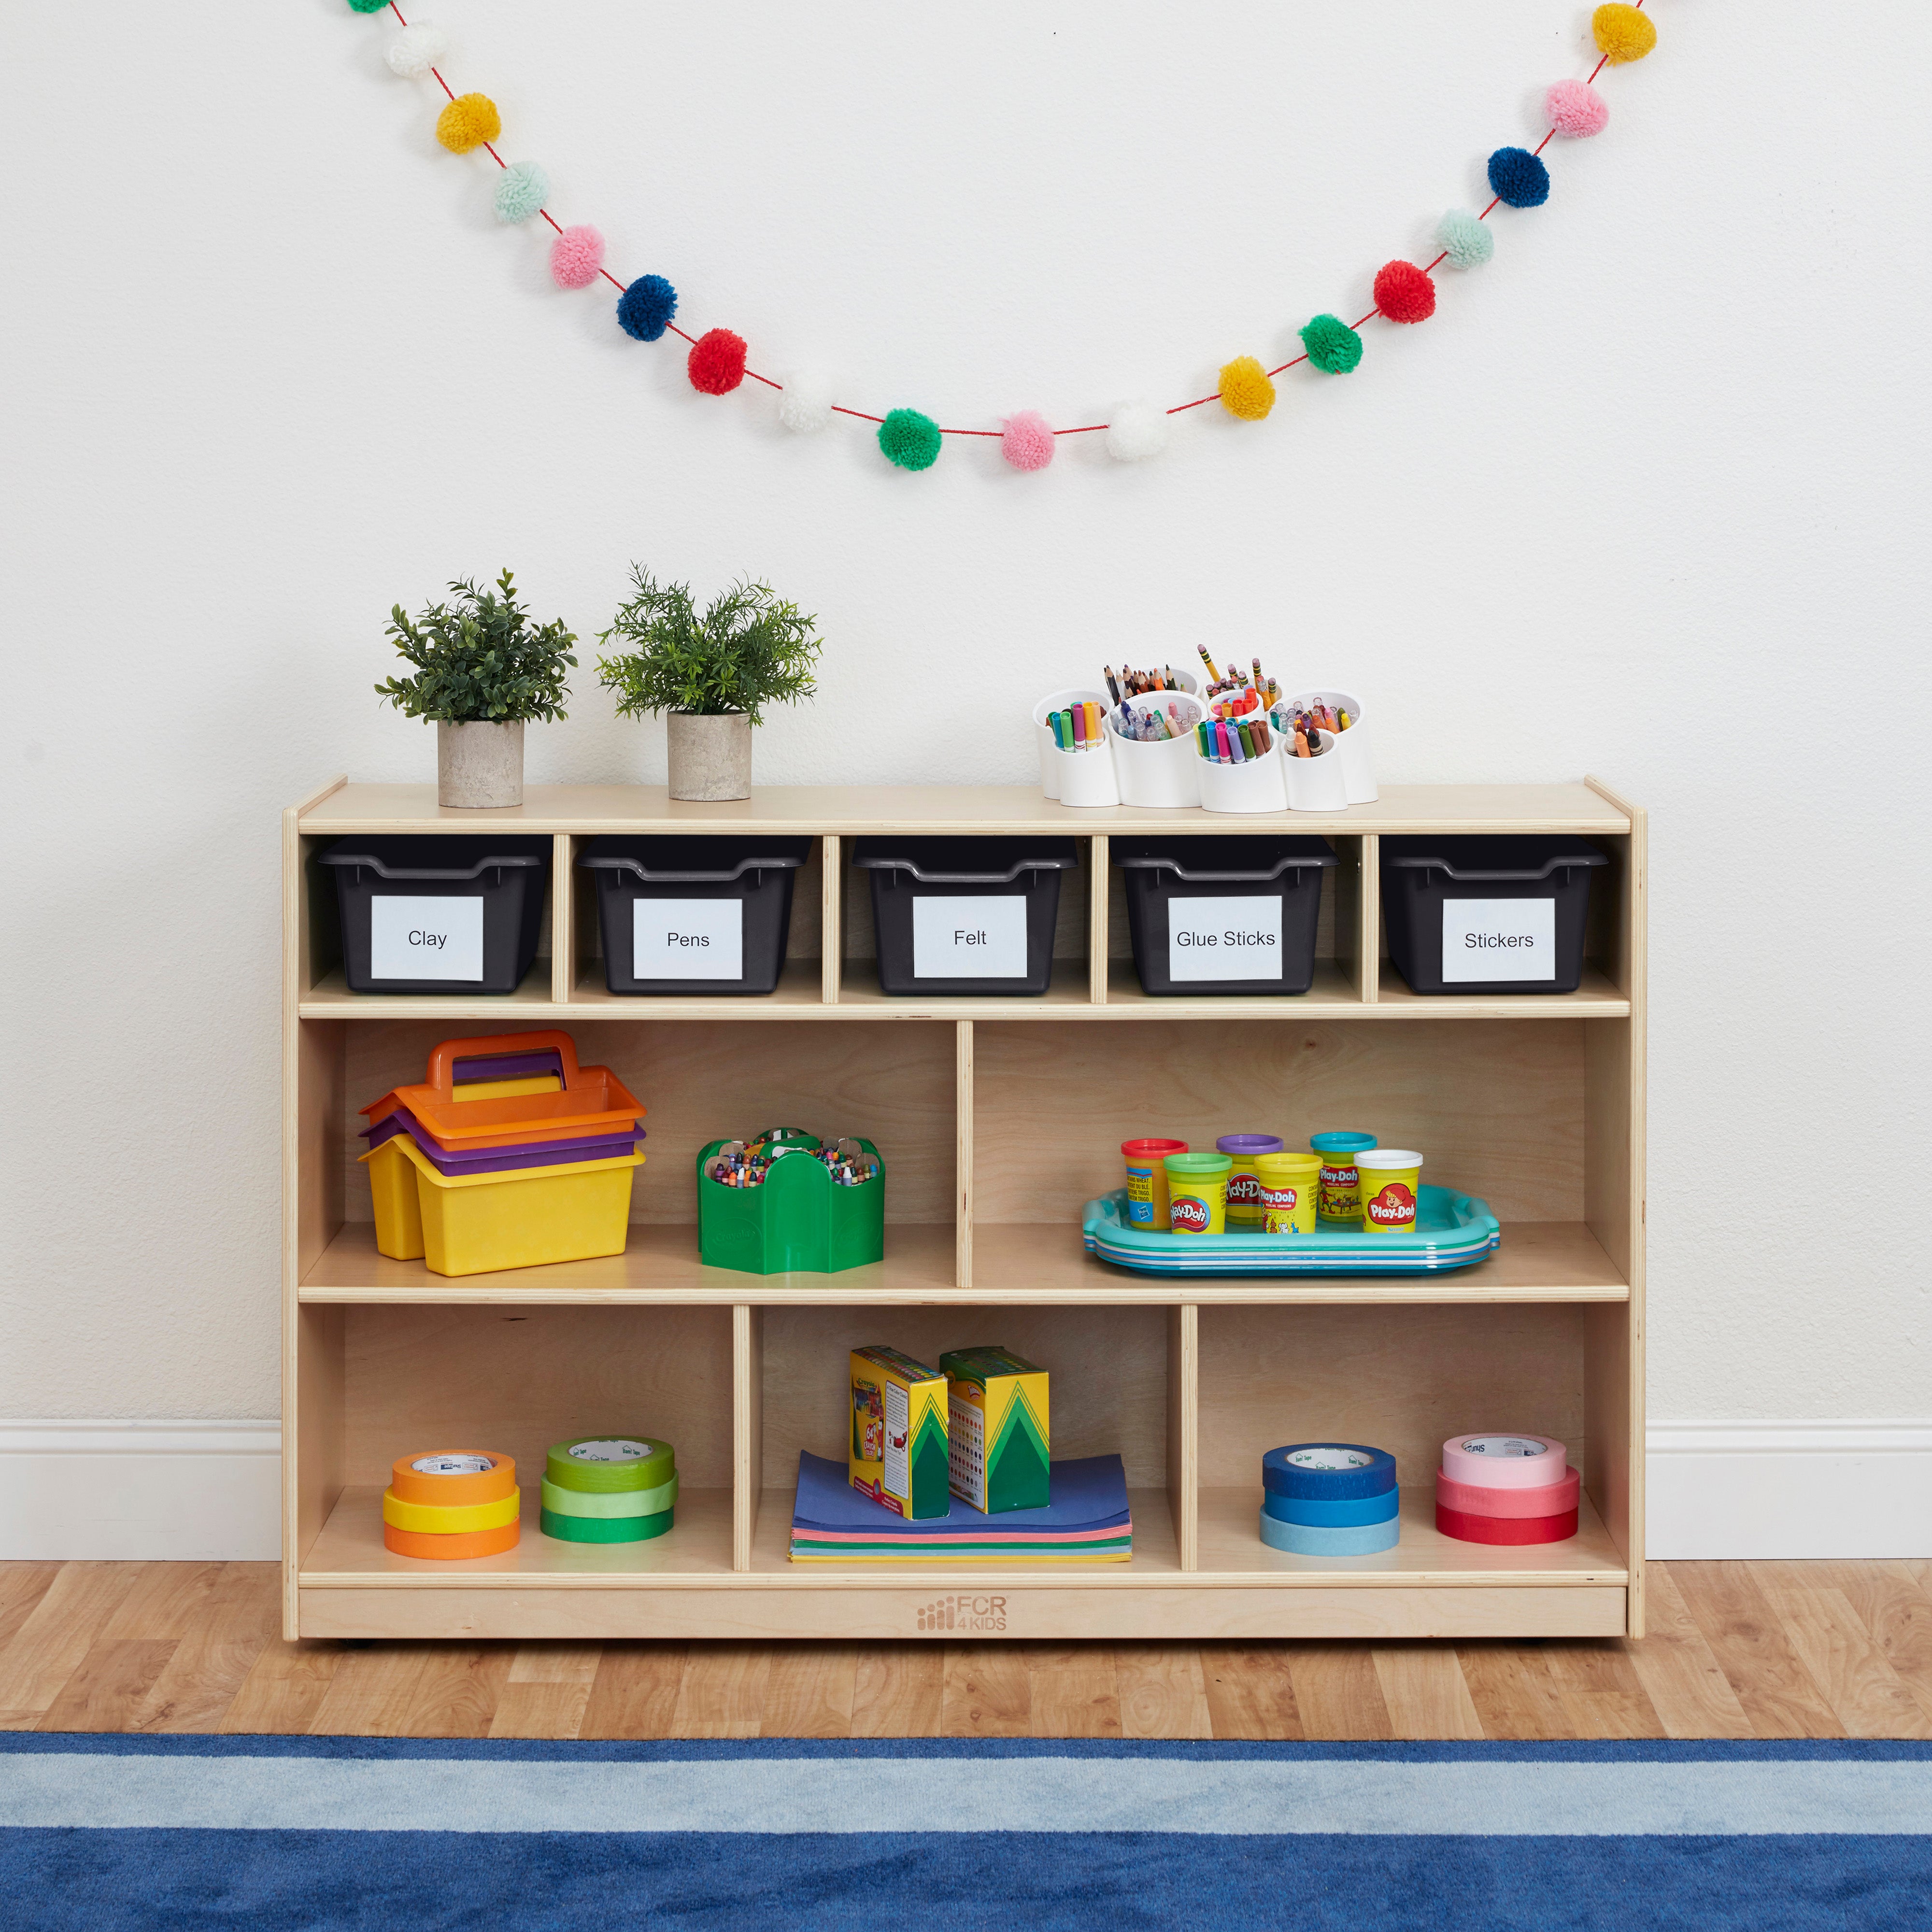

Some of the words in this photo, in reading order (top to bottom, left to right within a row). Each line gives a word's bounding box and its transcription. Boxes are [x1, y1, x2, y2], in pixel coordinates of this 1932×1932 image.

[409, 930, 447, 950] Clay
[668, 932, 710, 947] Pens
[954, 930, 987, 945] Felt
[1177, 932, 1217, 947] Glue
[1224, 931, 1275, 946] Sticks
[1465, 933, 1534, 948] Stickers
[1320, 1169, 1358, 1182] Play-Doh
[1261, 1189, 1295, 1204] Play-Doh
[1170, 1204, 1206, 1224] Play-Doh
[1371, 1204, 1415, 1219] Play-Doh
[866, 1428, 874, 1440] 64
[957, 1596, 1007, 1616] FCR
[957, 1617, 966, 1630] 4
[969, 1617, 1007, 1631] KIDS
